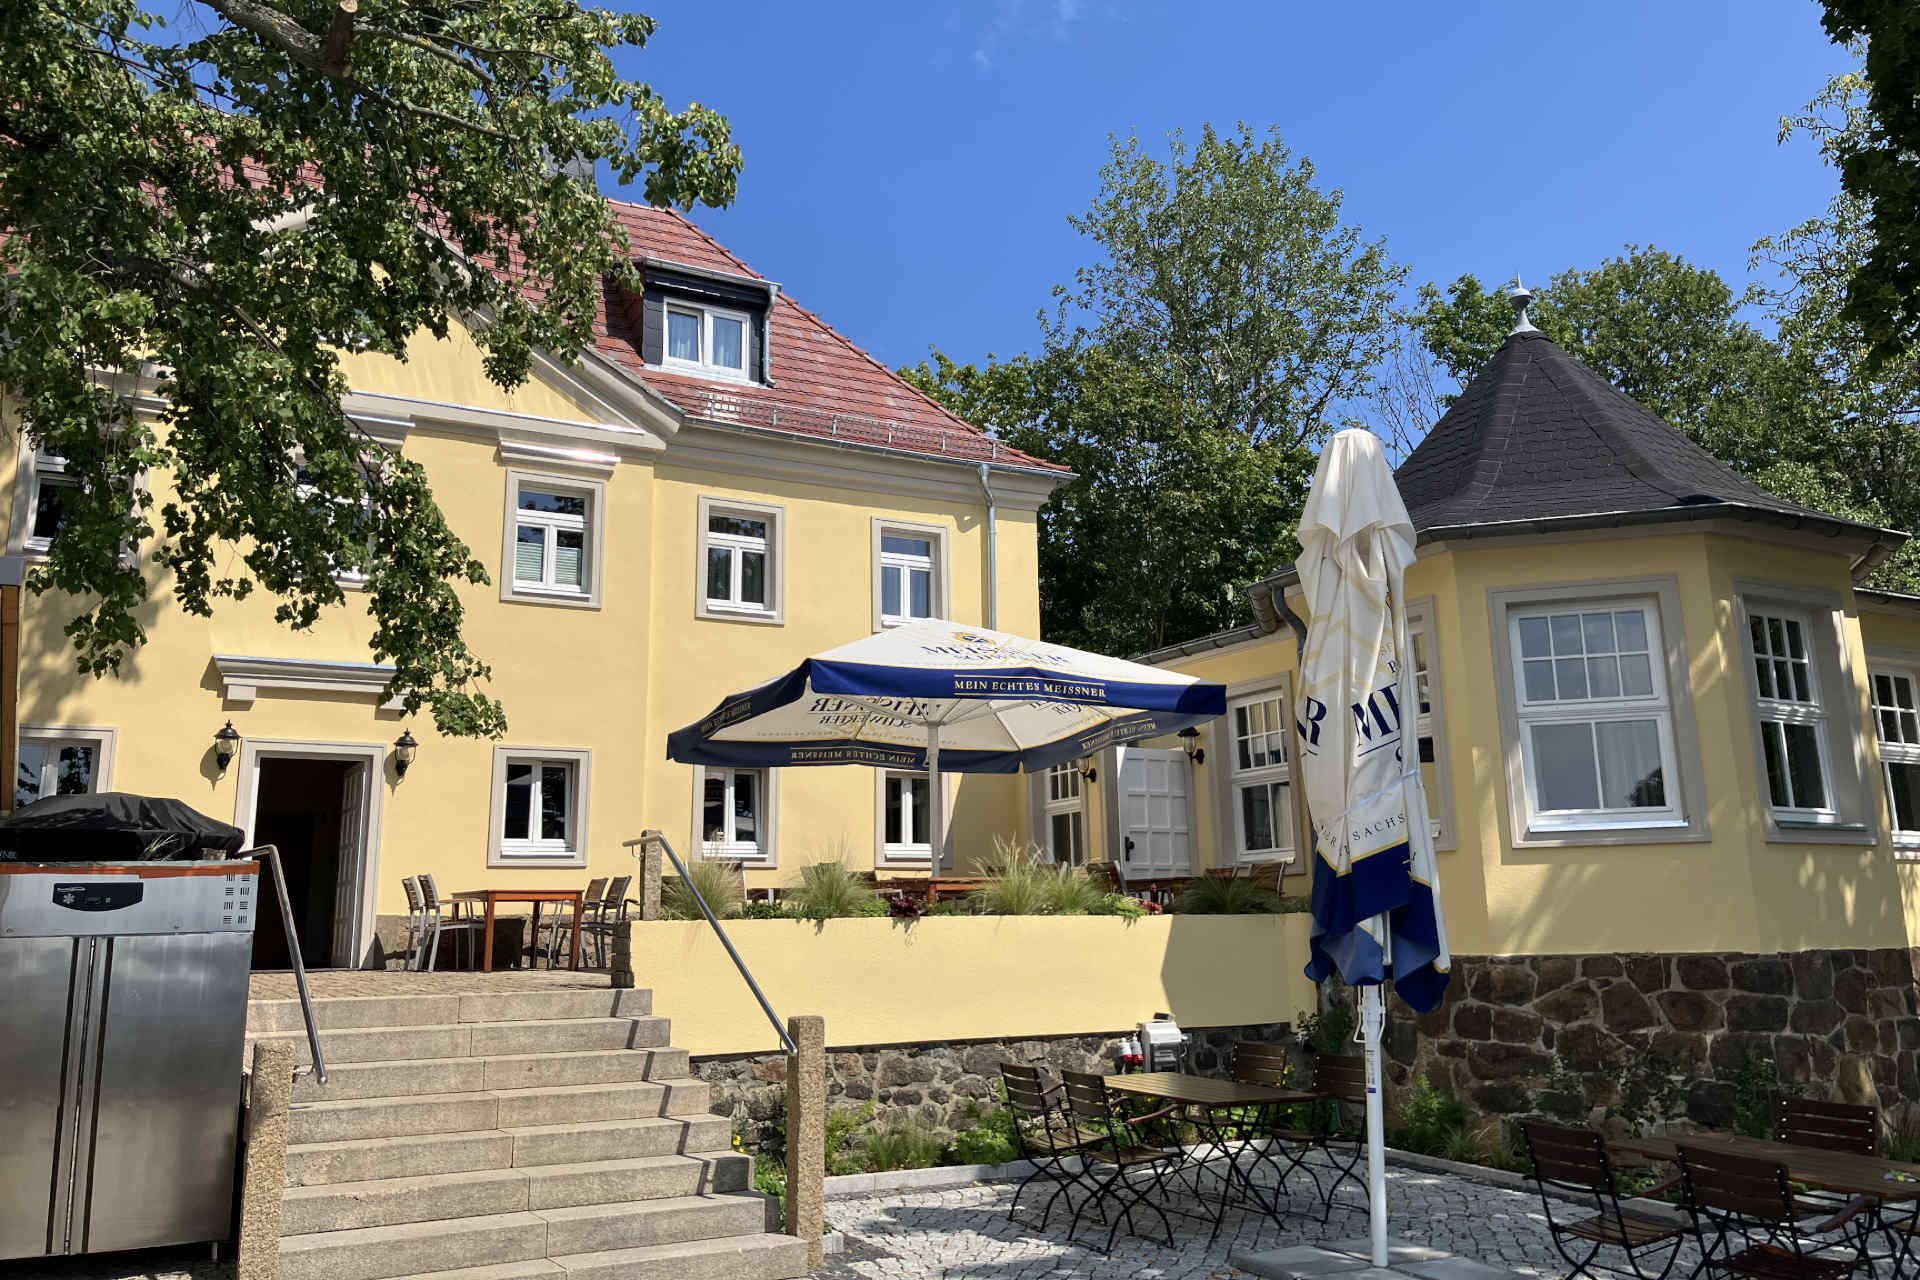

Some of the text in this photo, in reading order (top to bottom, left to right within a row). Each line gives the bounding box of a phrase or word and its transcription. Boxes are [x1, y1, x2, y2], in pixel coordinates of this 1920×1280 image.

[954, 680, 1106, 697] MEIN ECHTES MEISSNER
[1352, 812, 1407, 841] SACHS
